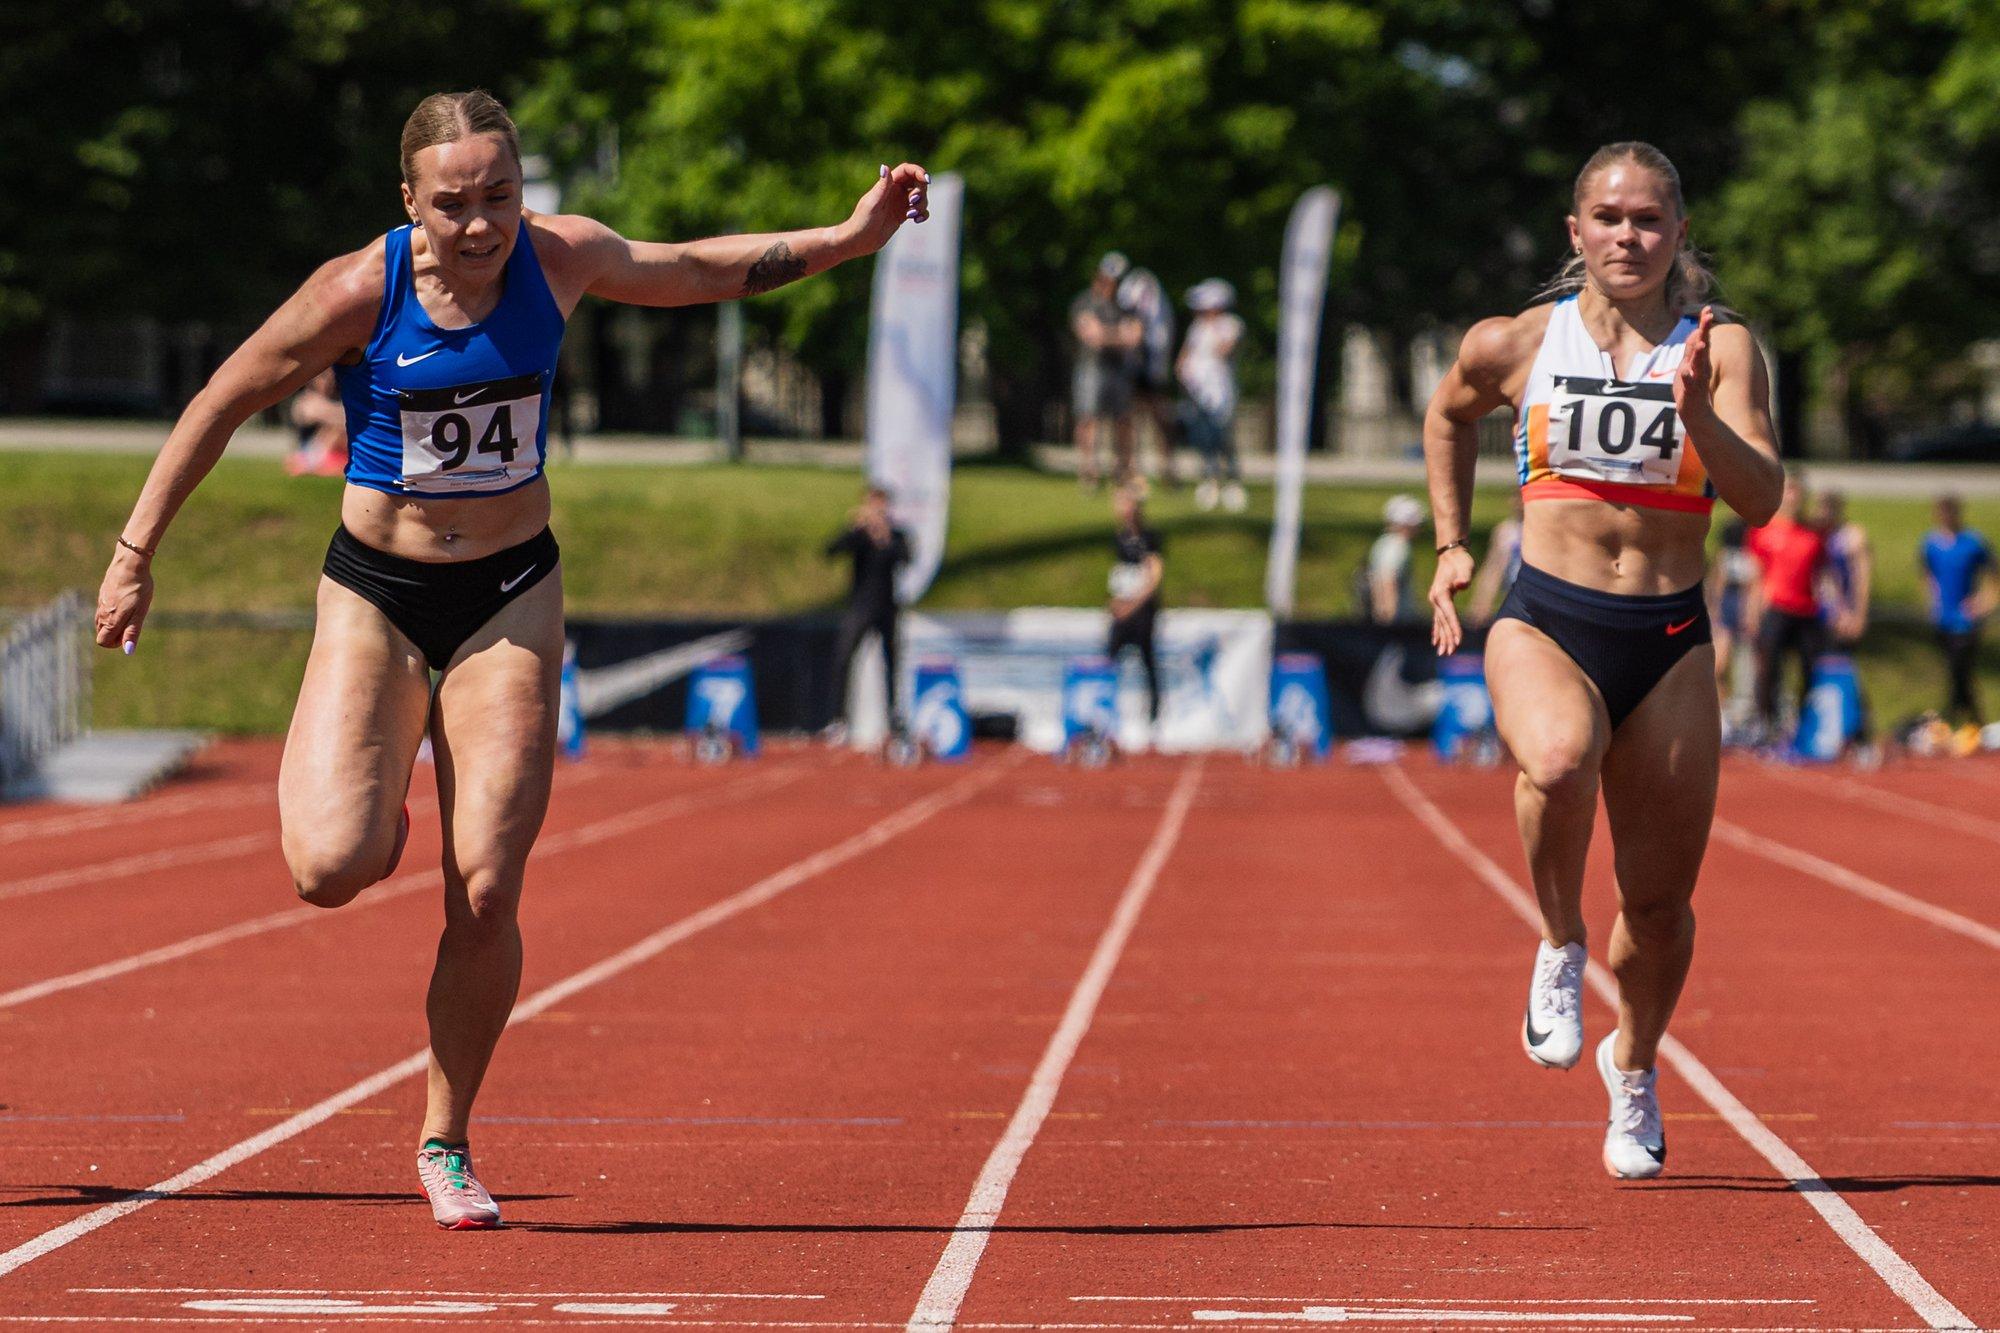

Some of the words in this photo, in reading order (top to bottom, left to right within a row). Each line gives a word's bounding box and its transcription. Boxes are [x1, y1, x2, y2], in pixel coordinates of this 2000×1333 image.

[431, 404, 519, 471] 94
[1560, 399, 1680, 460] 104
[695, 677, 747, 733] 7
